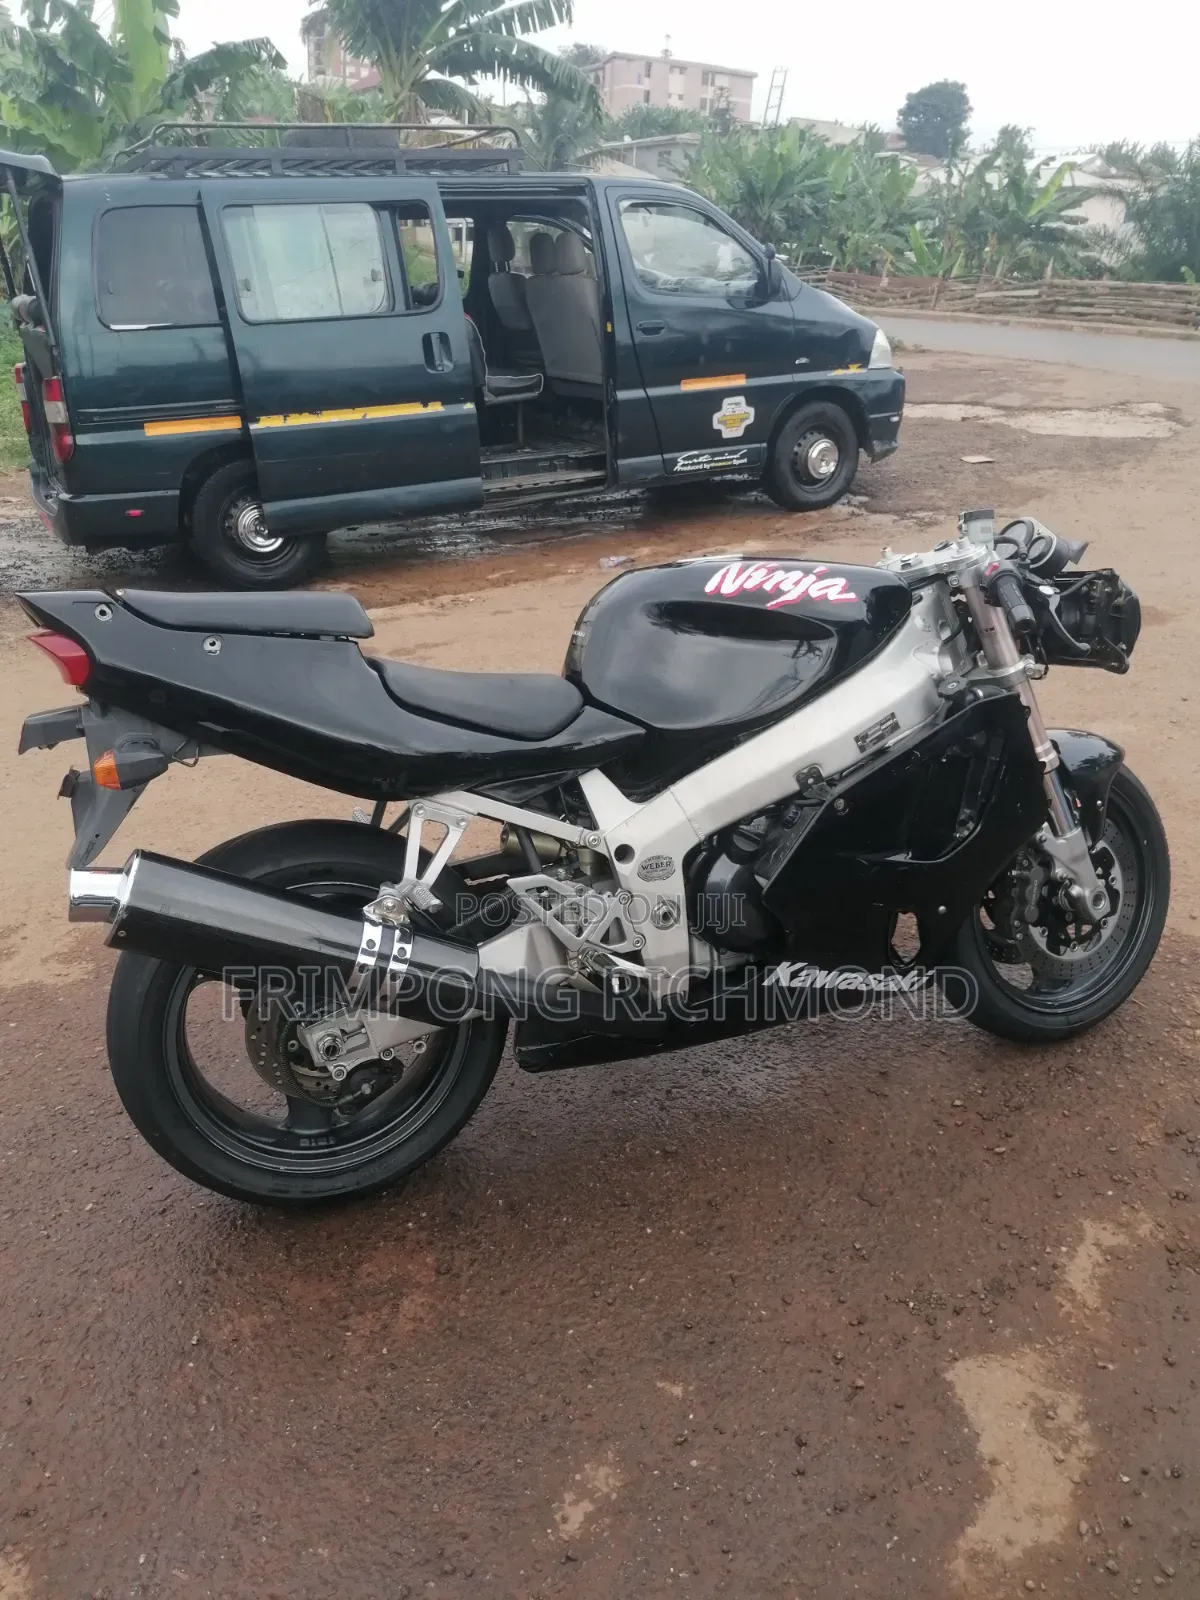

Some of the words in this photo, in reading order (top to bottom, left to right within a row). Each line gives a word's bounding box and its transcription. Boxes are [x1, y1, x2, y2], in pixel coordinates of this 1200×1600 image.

[704, 562, 858, 609] Ninja
[641, 860, 672, 871] WEBER
[761, 961, 935, 992] Kawasaki
